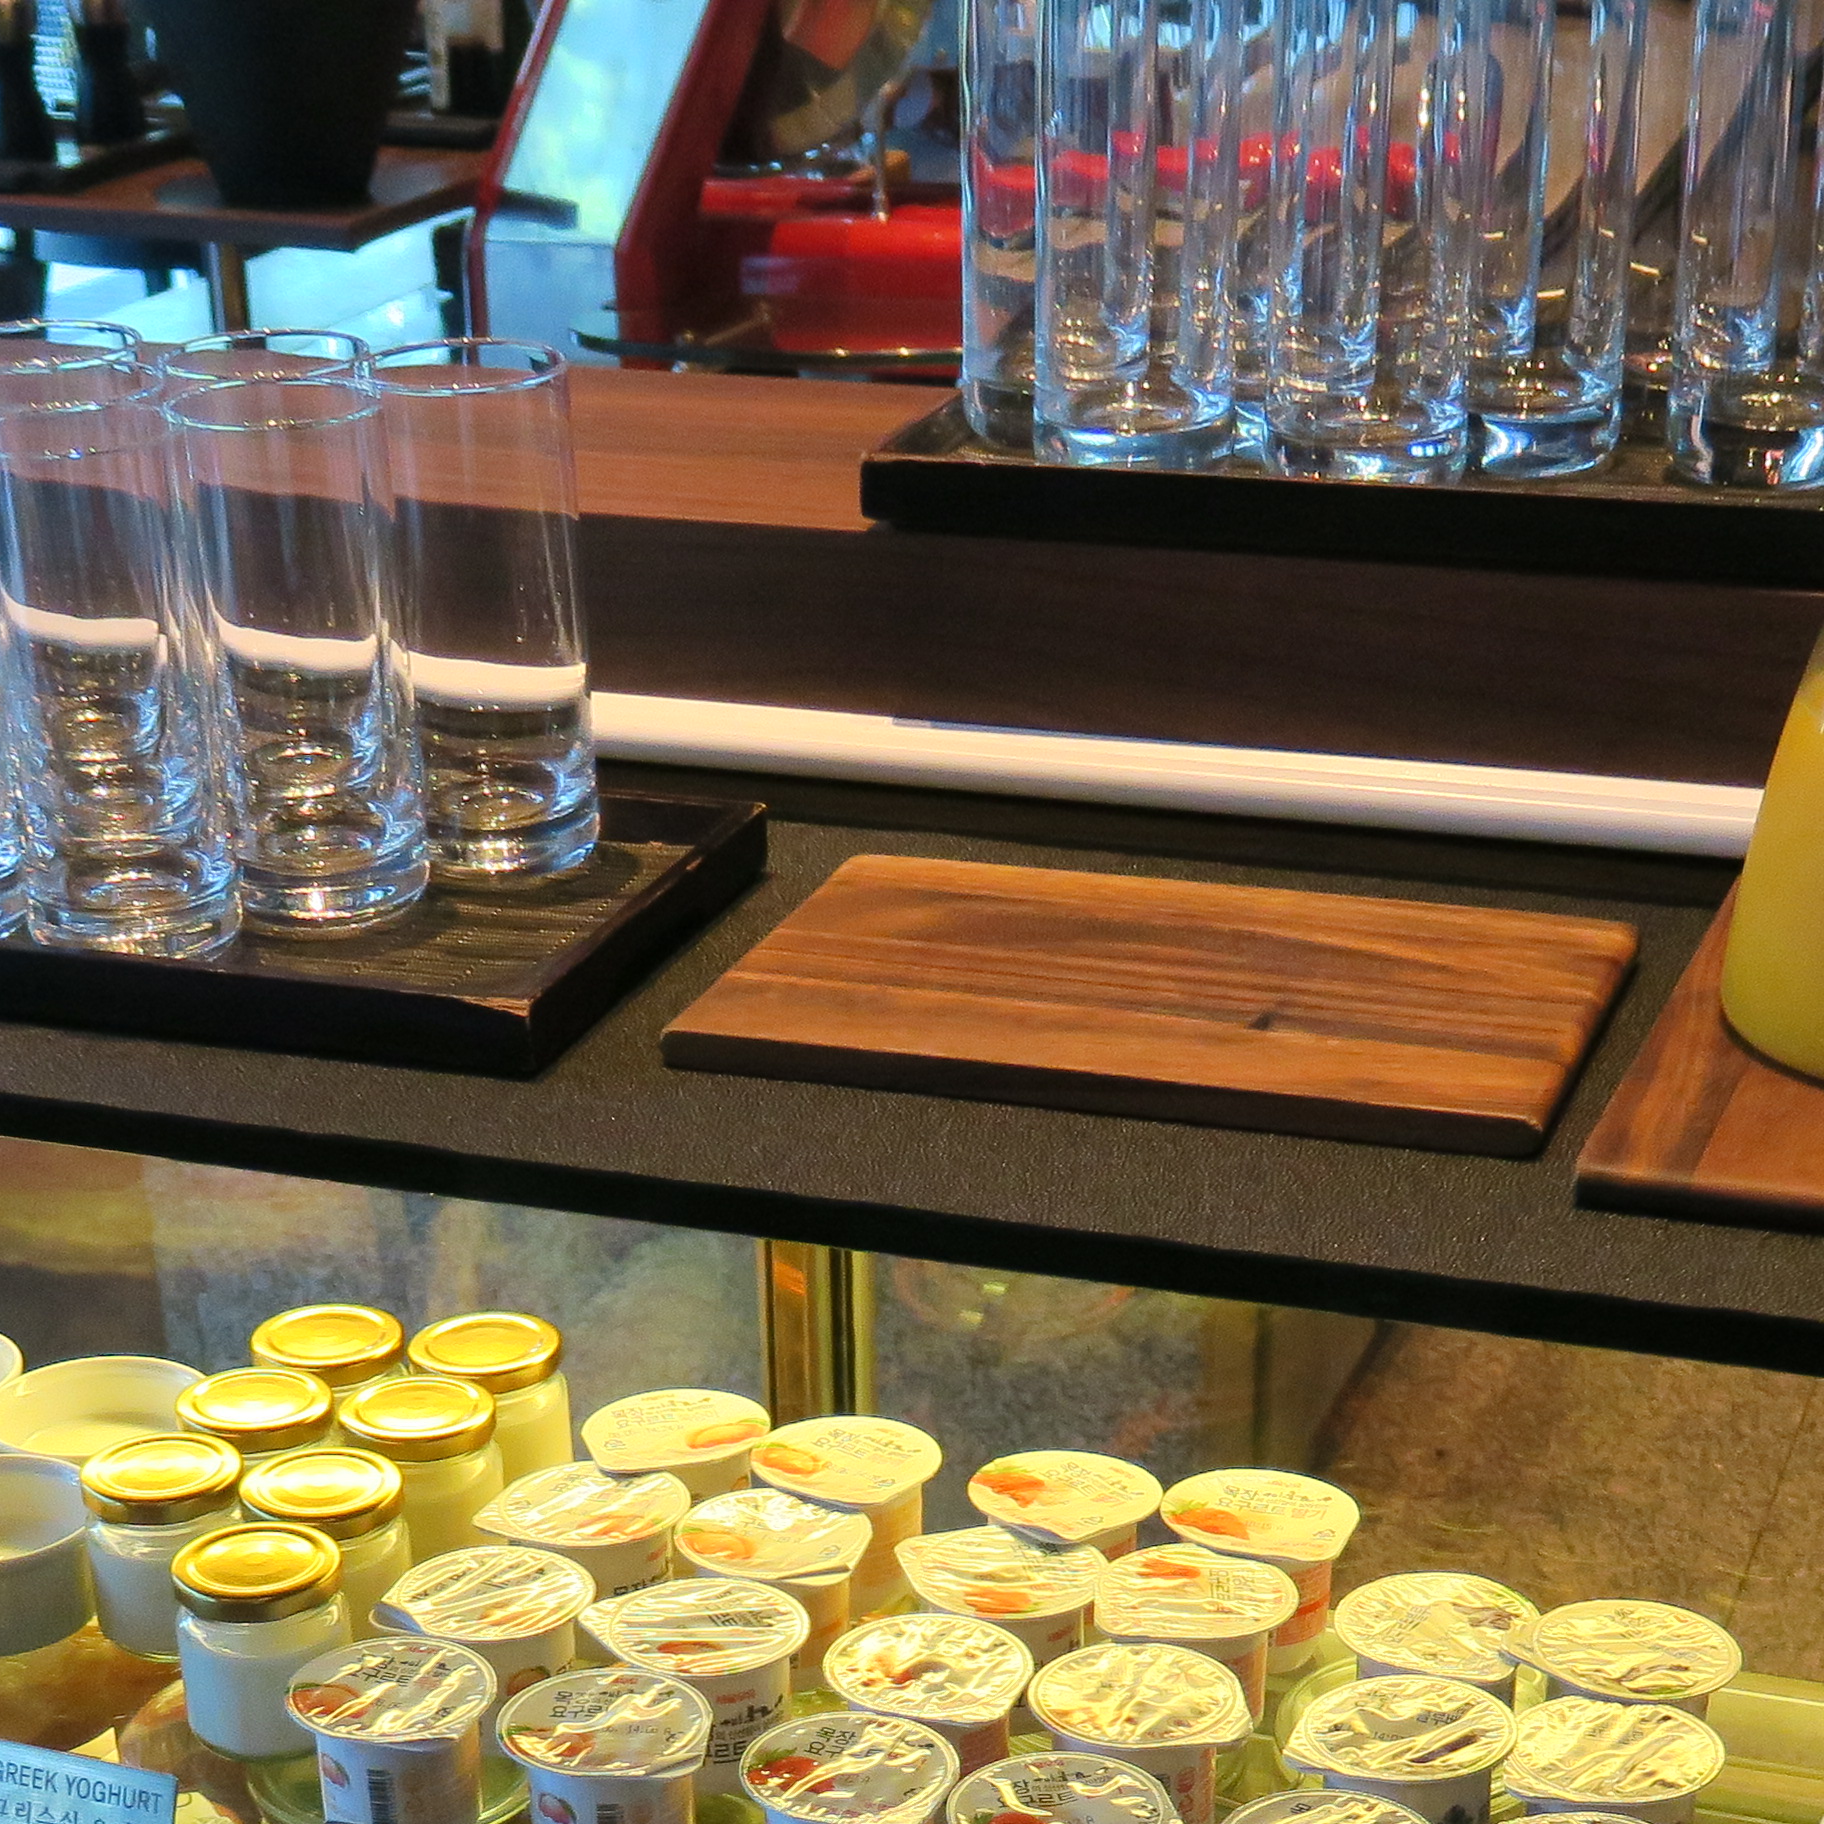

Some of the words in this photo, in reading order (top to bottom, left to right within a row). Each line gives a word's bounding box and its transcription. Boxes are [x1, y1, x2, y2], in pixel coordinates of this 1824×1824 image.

[1223, 1485, 1259, 1500] 목장
[1216, 1497, 1286, 1516] 요구르트
[64, 1772, 163, 1815] YOGHURT
